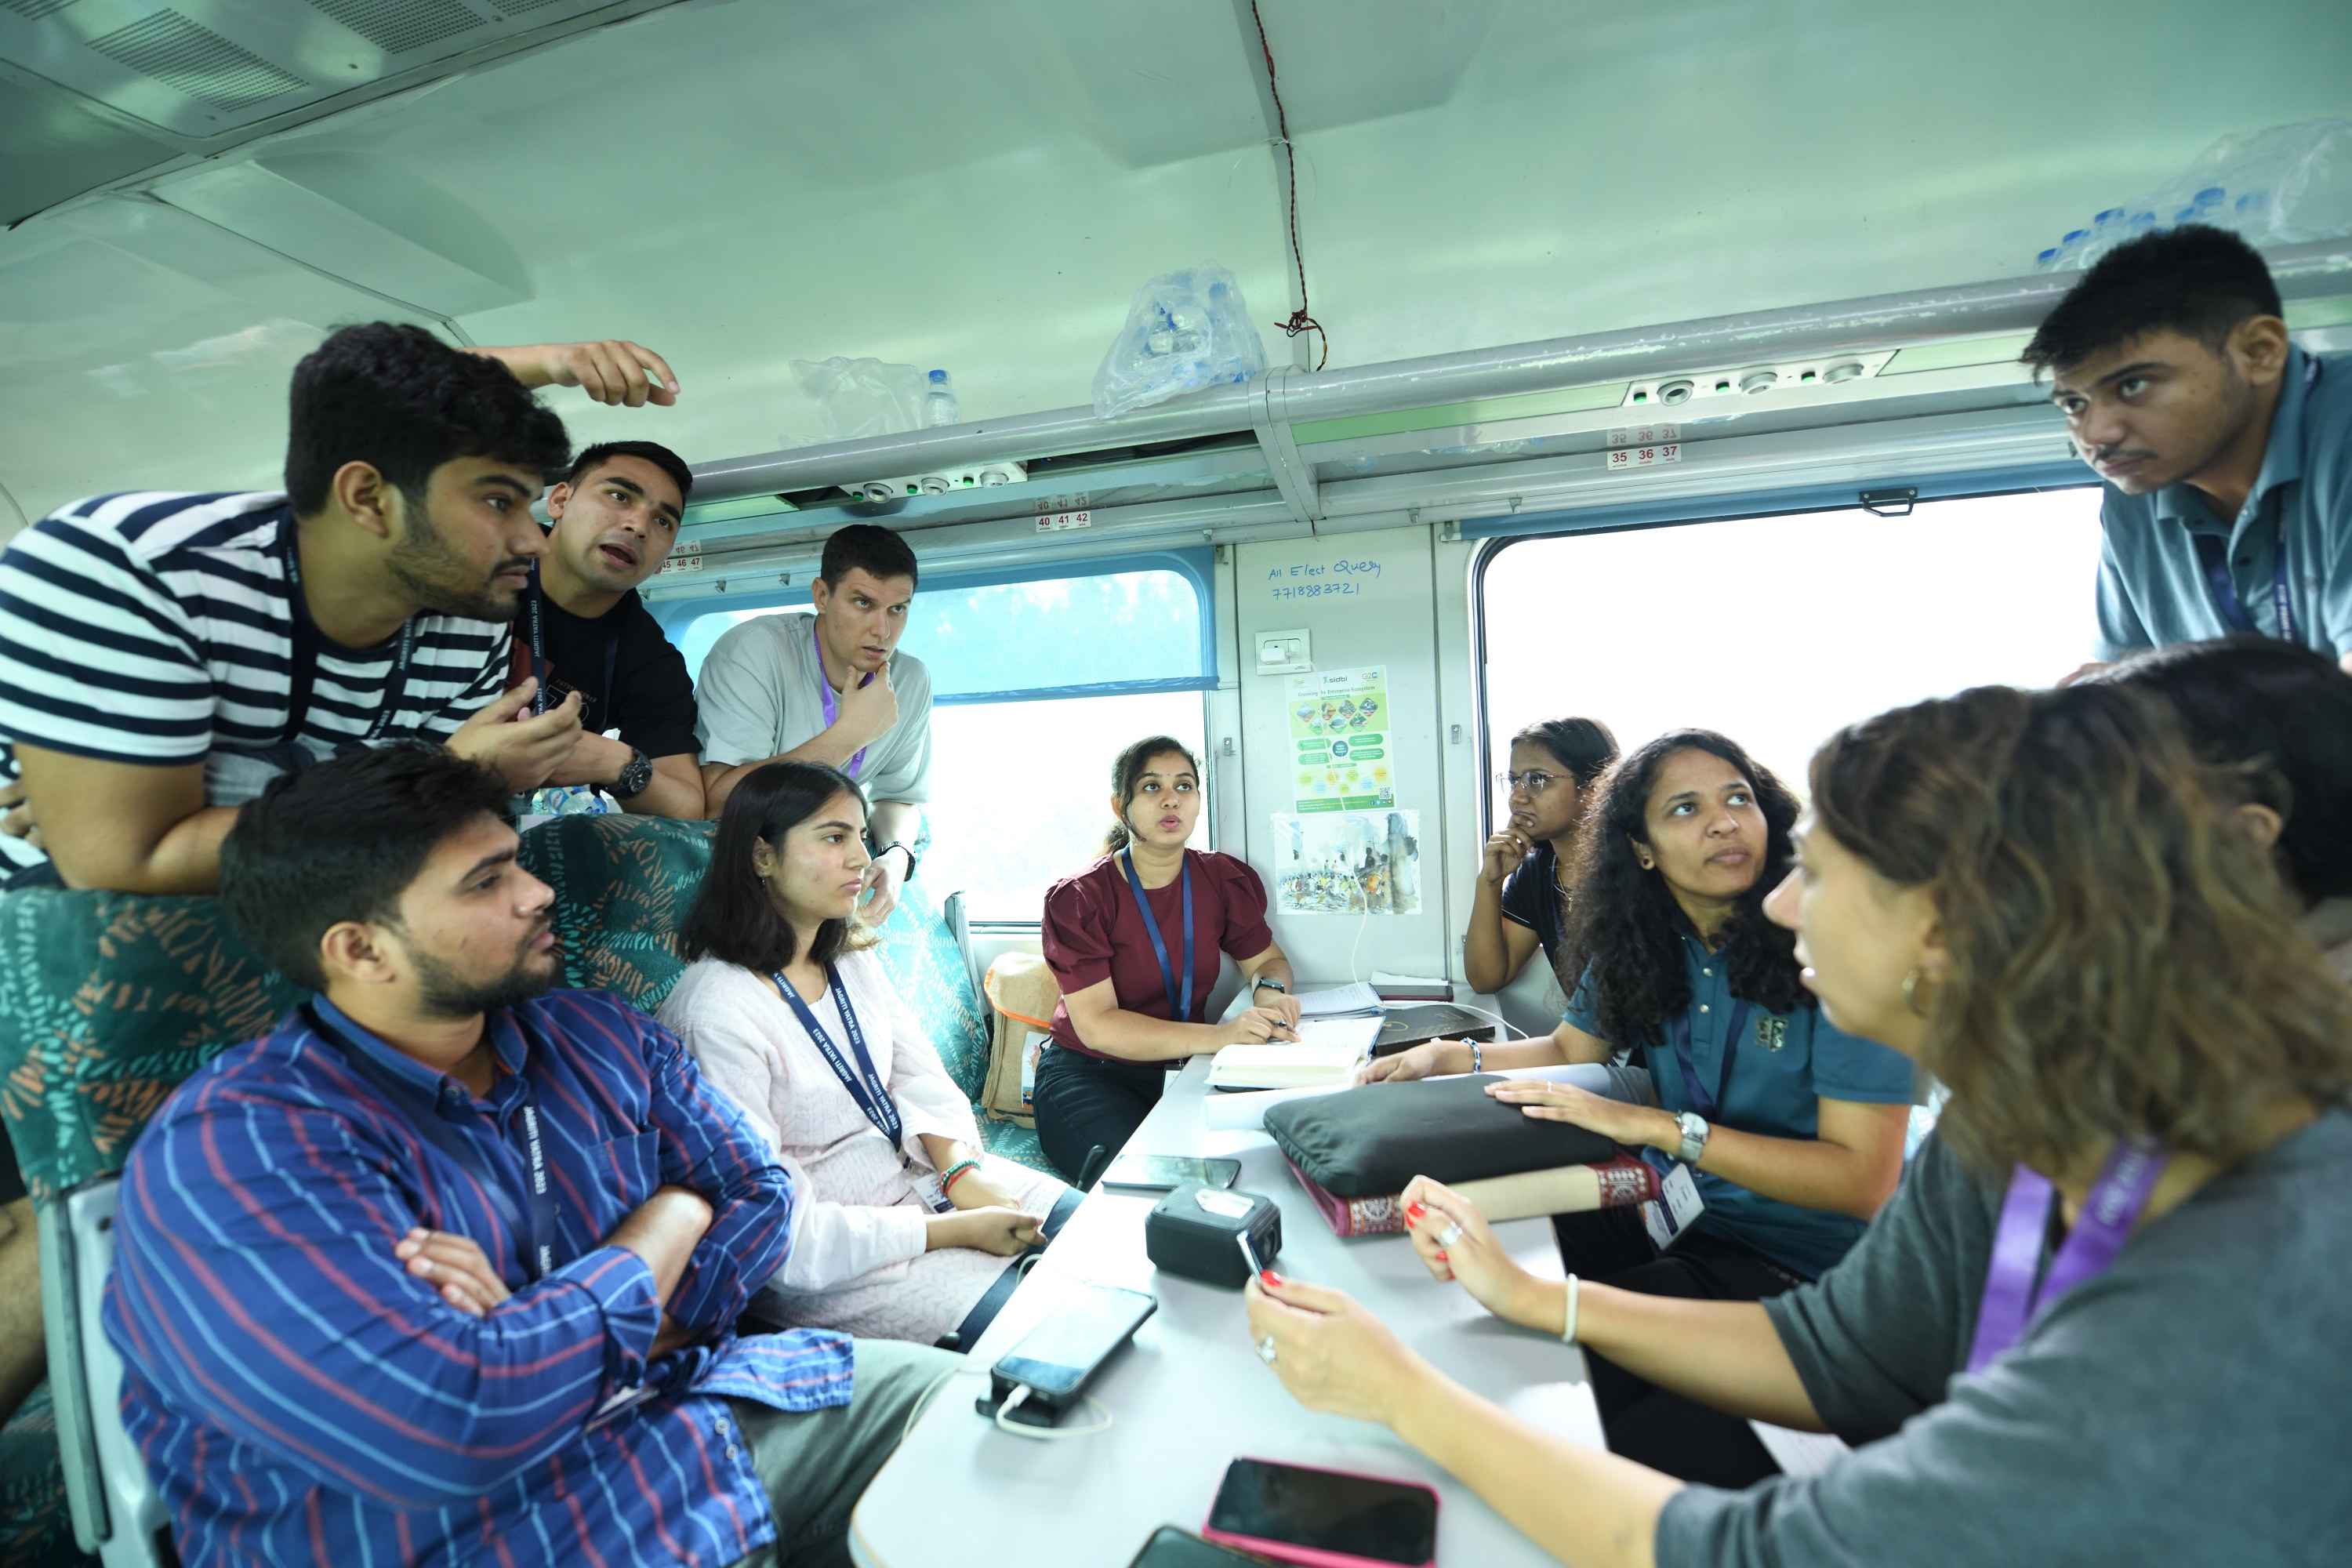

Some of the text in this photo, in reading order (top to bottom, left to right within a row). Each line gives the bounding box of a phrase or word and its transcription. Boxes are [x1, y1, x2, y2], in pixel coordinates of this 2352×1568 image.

[1612, 446, 1678, 463] 35 36 37
[1039, 513, 1088, 526] 40 41 42
[1269, 568, 1282, 580] All
[1290, 564, 1325, 576] Elect
[1272, 583, 1359, 601] 7718883721
[835, 987, 848, 1011] JAGRITI
[844, 1009, 855, 1029] YATRA
[822, 1042, 837, 1062] YATRA
[834, 1060, 852, 1082] JAGRITI
[867, 1073, 882, 1096] JAGRITI
[879, 1094, 892, 1115] YATRA
